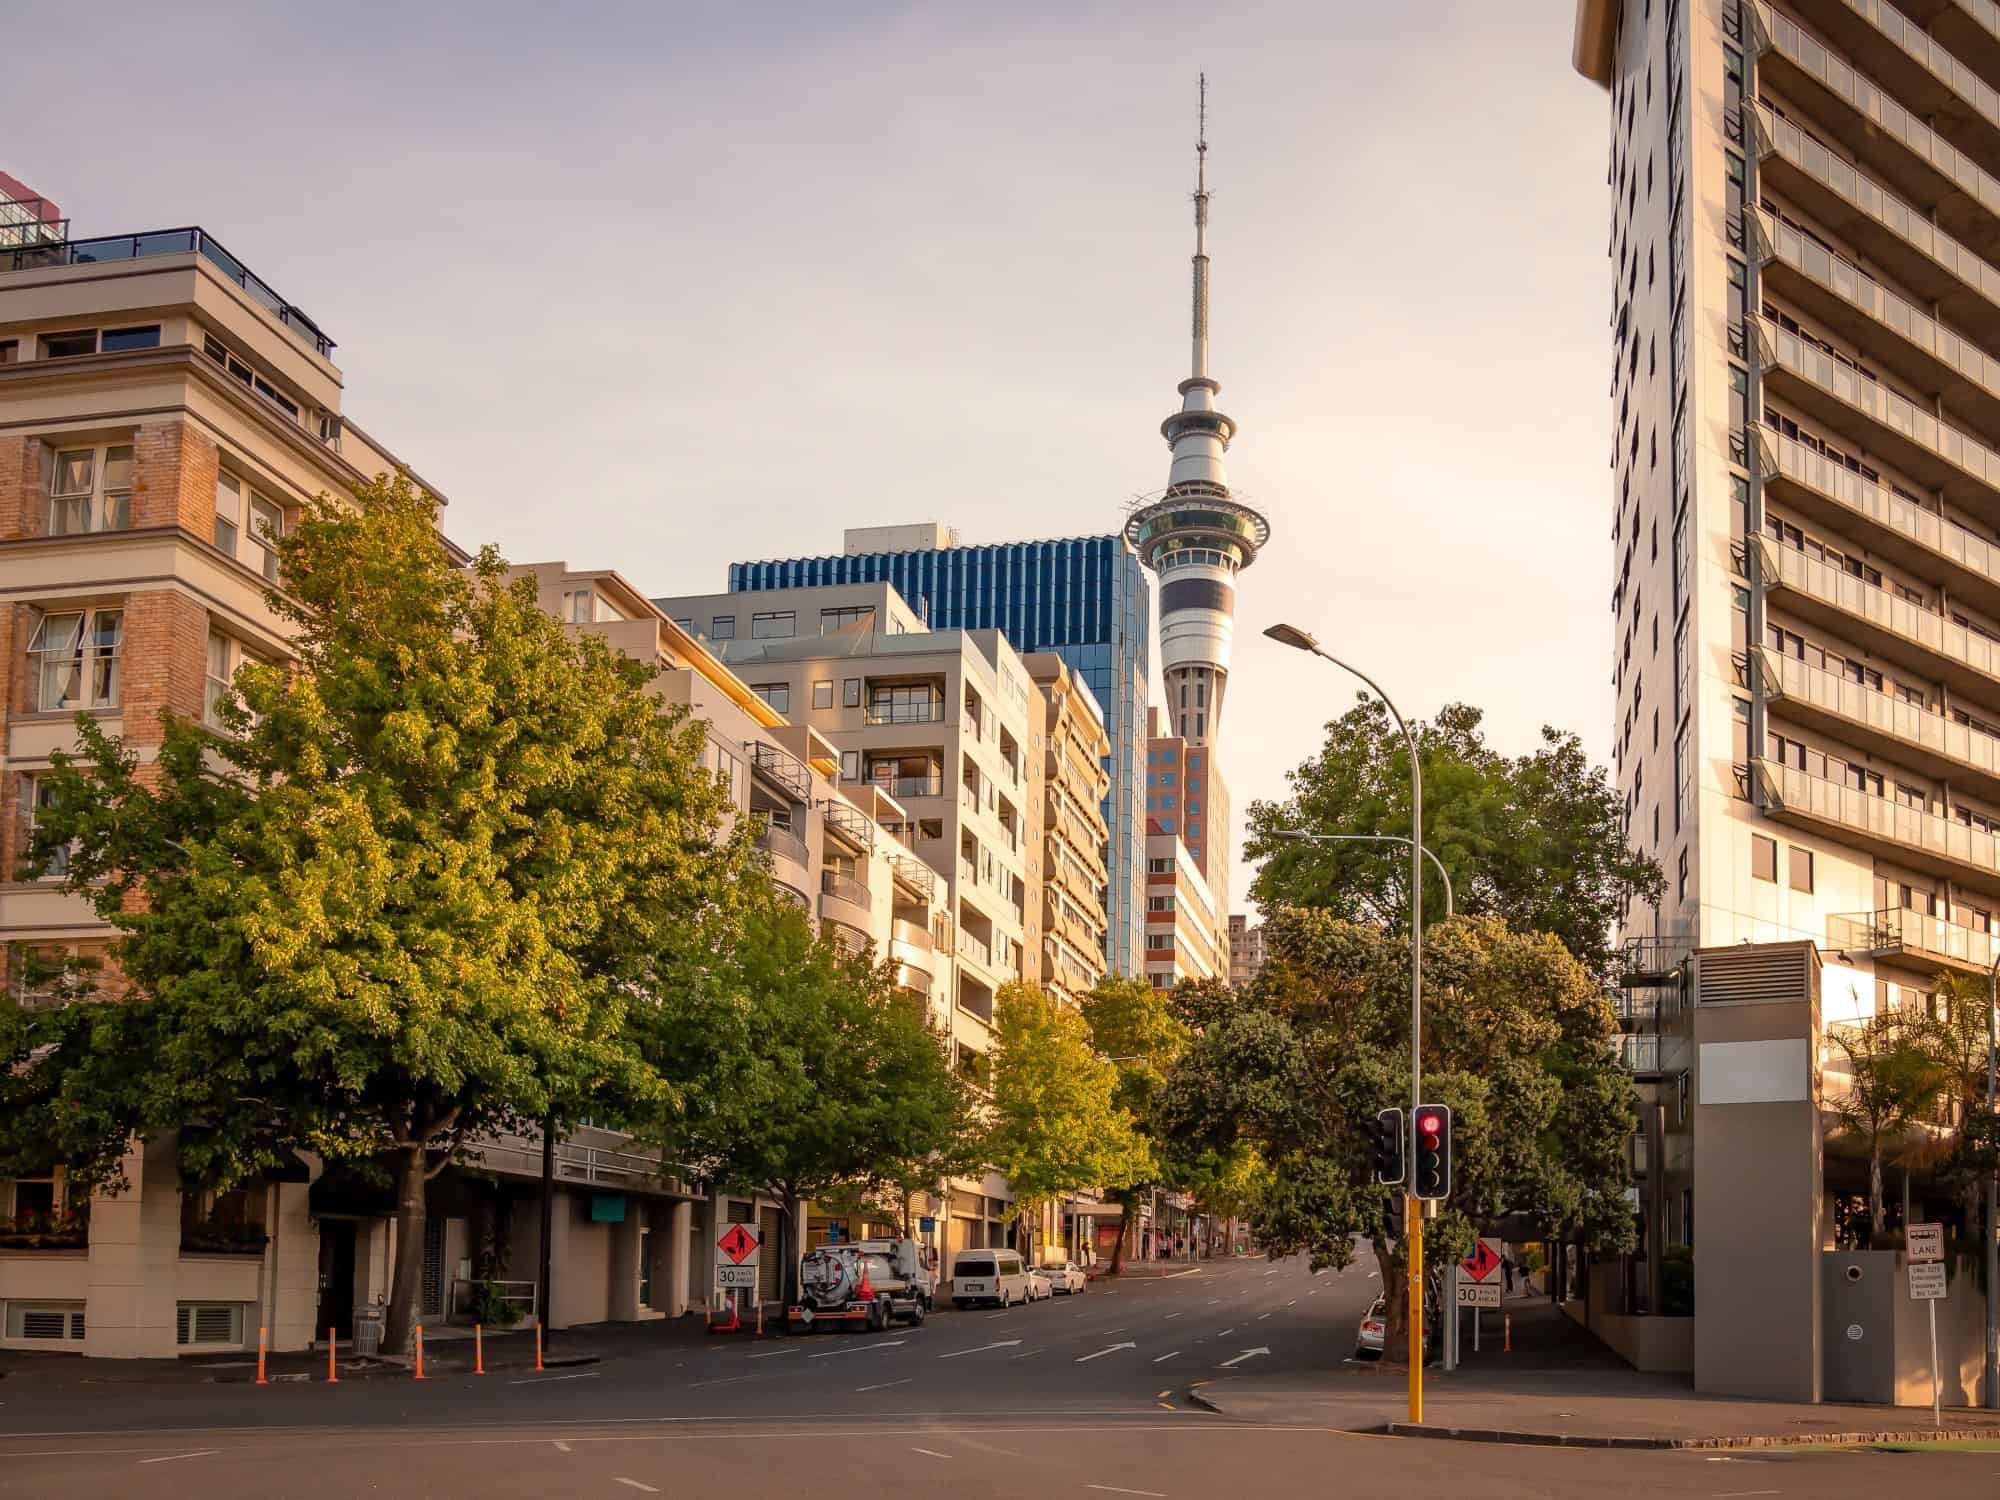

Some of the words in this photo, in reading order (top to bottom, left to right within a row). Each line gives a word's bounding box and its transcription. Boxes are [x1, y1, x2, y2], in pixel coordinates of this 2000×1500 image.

[1912, 1247, 1937, 1255] LANE
[720, 1270, 735, 1282] 30
[1458, 1288, 1477, 1301] 30
